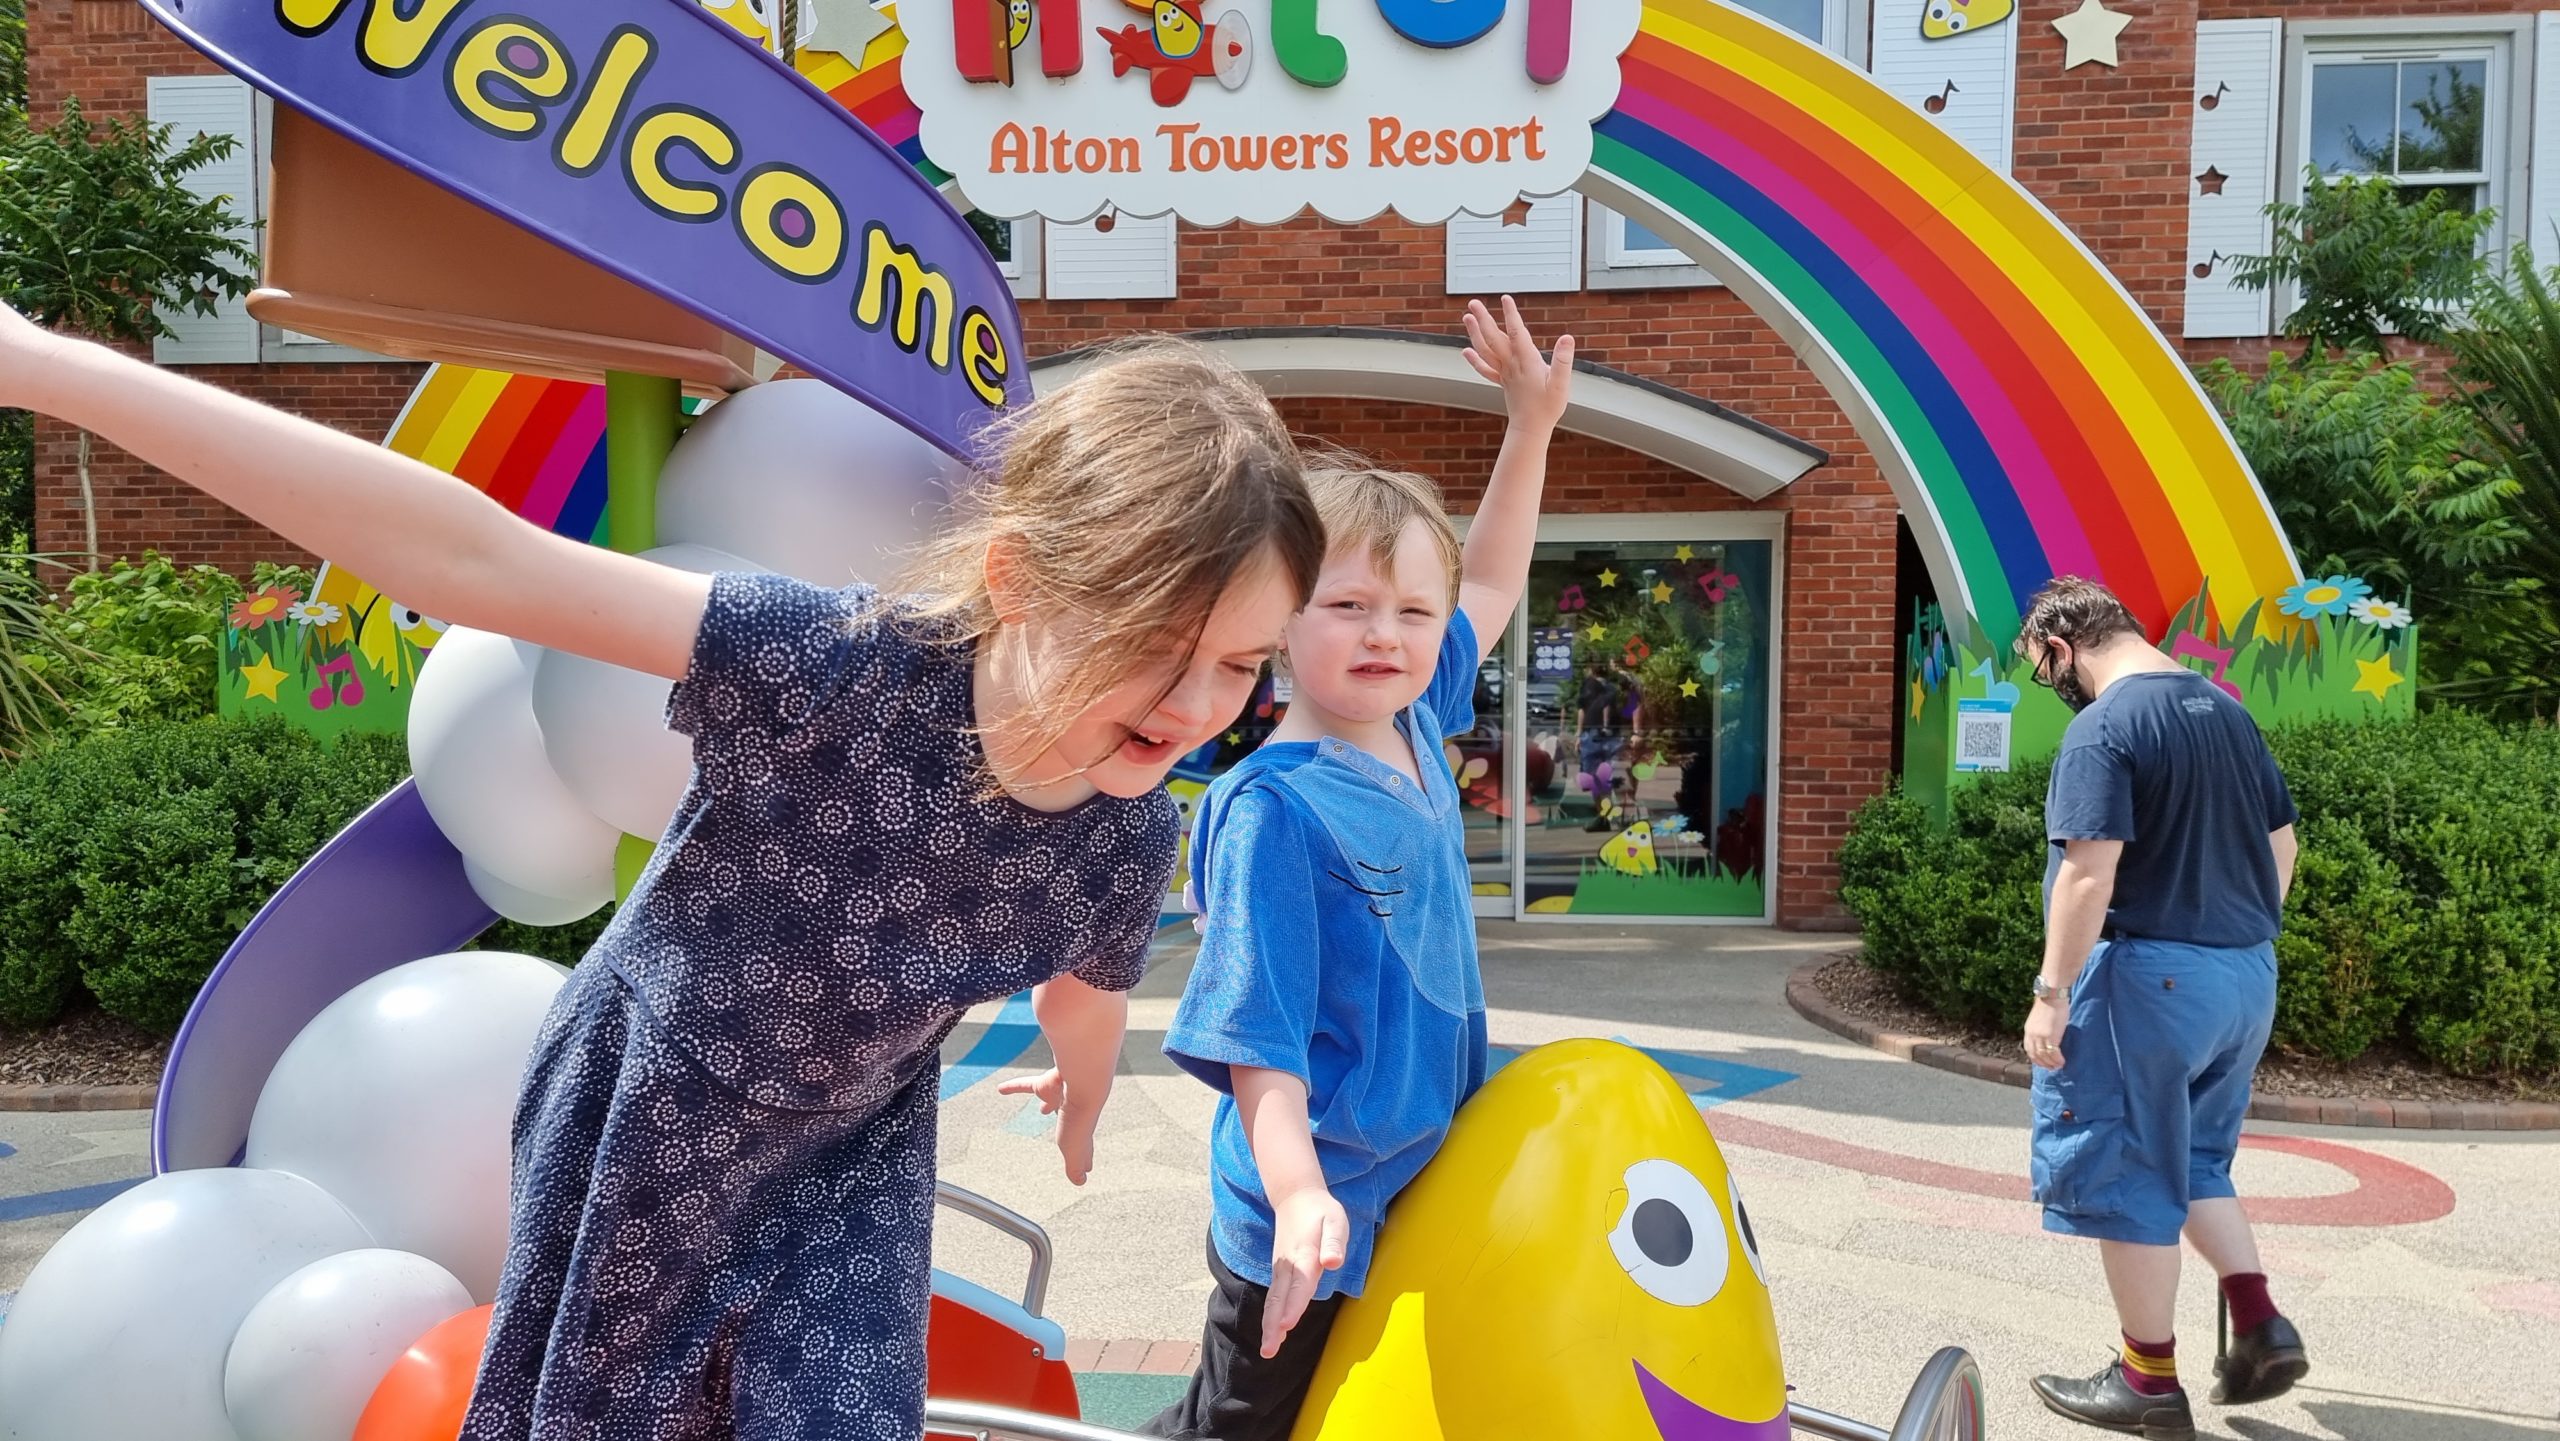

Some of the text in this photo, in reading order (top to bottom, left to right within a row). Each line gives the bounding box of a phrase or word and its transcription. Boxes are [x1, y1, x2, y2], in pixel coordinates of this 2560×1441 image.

[989, 115, 1546, 173] Alton Towers Resort
